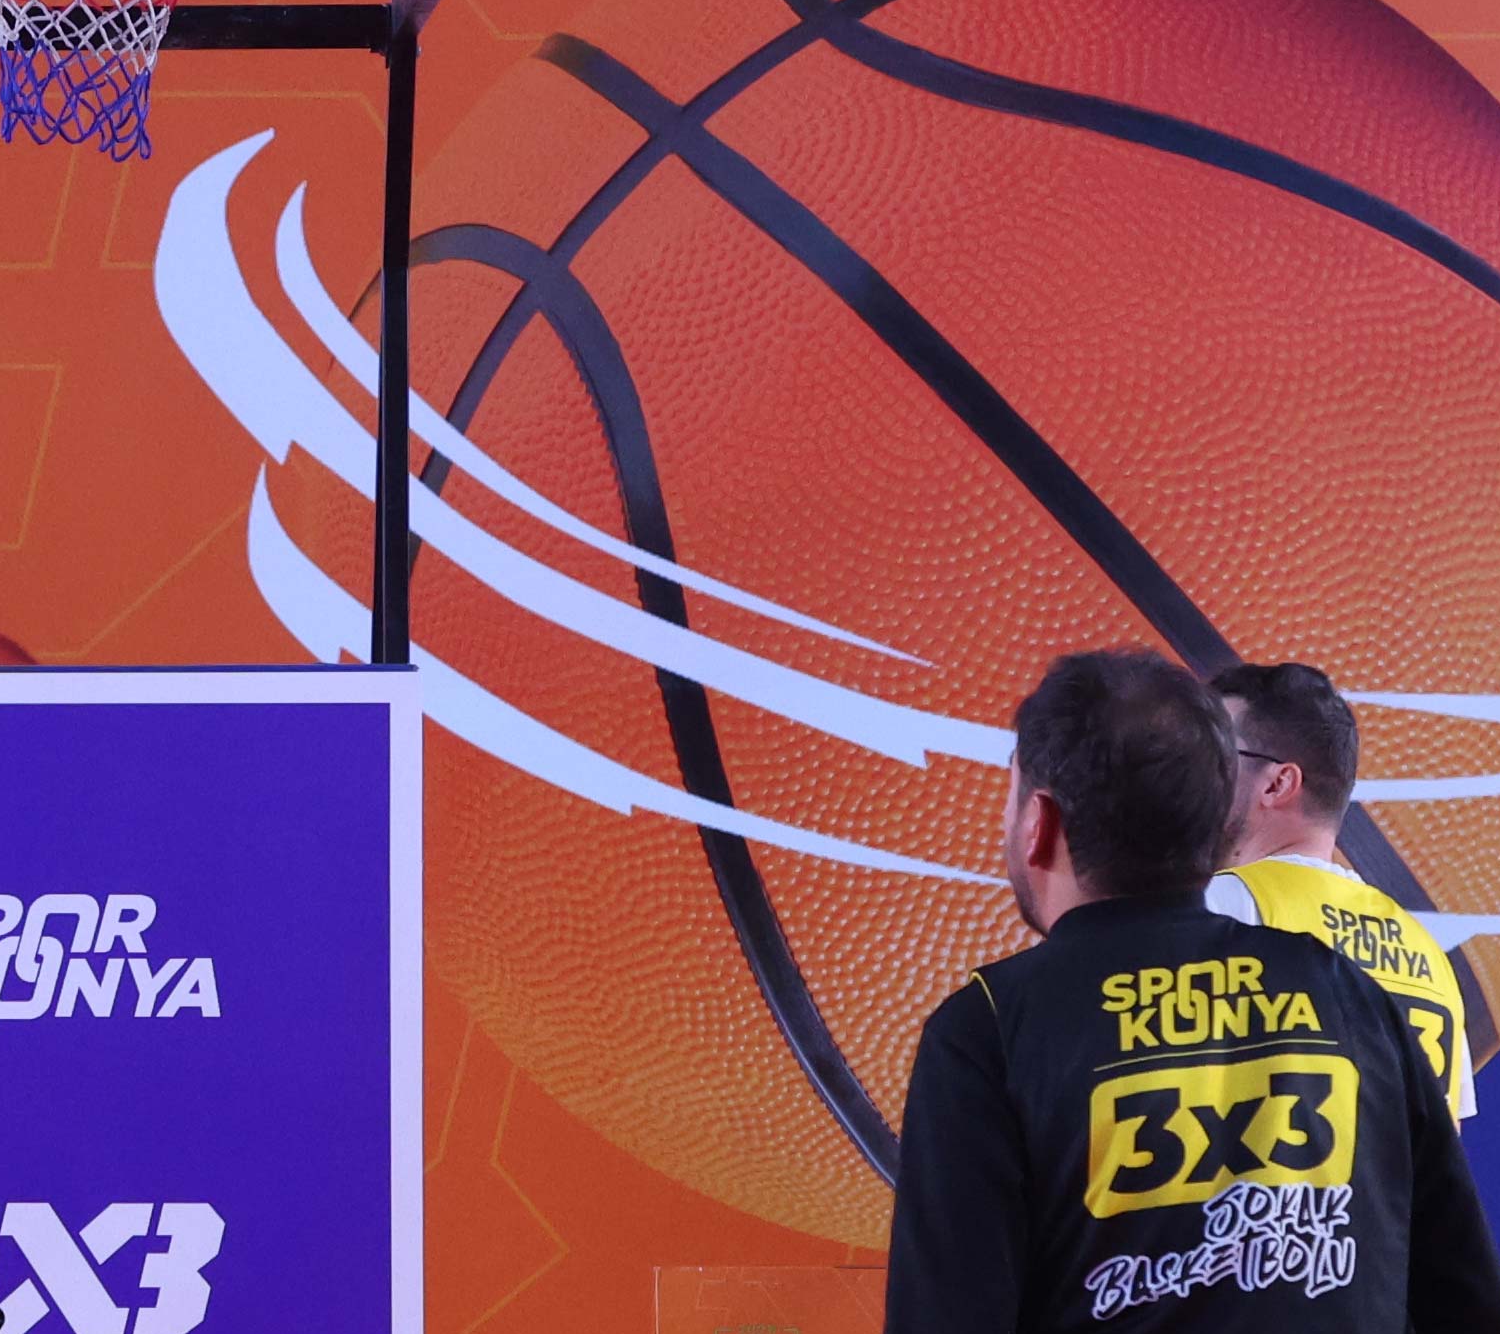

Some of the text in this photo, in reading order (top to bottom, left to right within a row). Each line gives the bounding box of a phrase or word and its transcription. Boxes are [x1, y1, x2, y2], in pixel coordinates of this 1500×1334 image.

[1322, 903, 1403, 951] SPOR
[1333, 925, 1432, 983] KONYA
[1101, 956, 1264, 1019] SPOR
[1120, 986, 1322, 1051] KONYA
